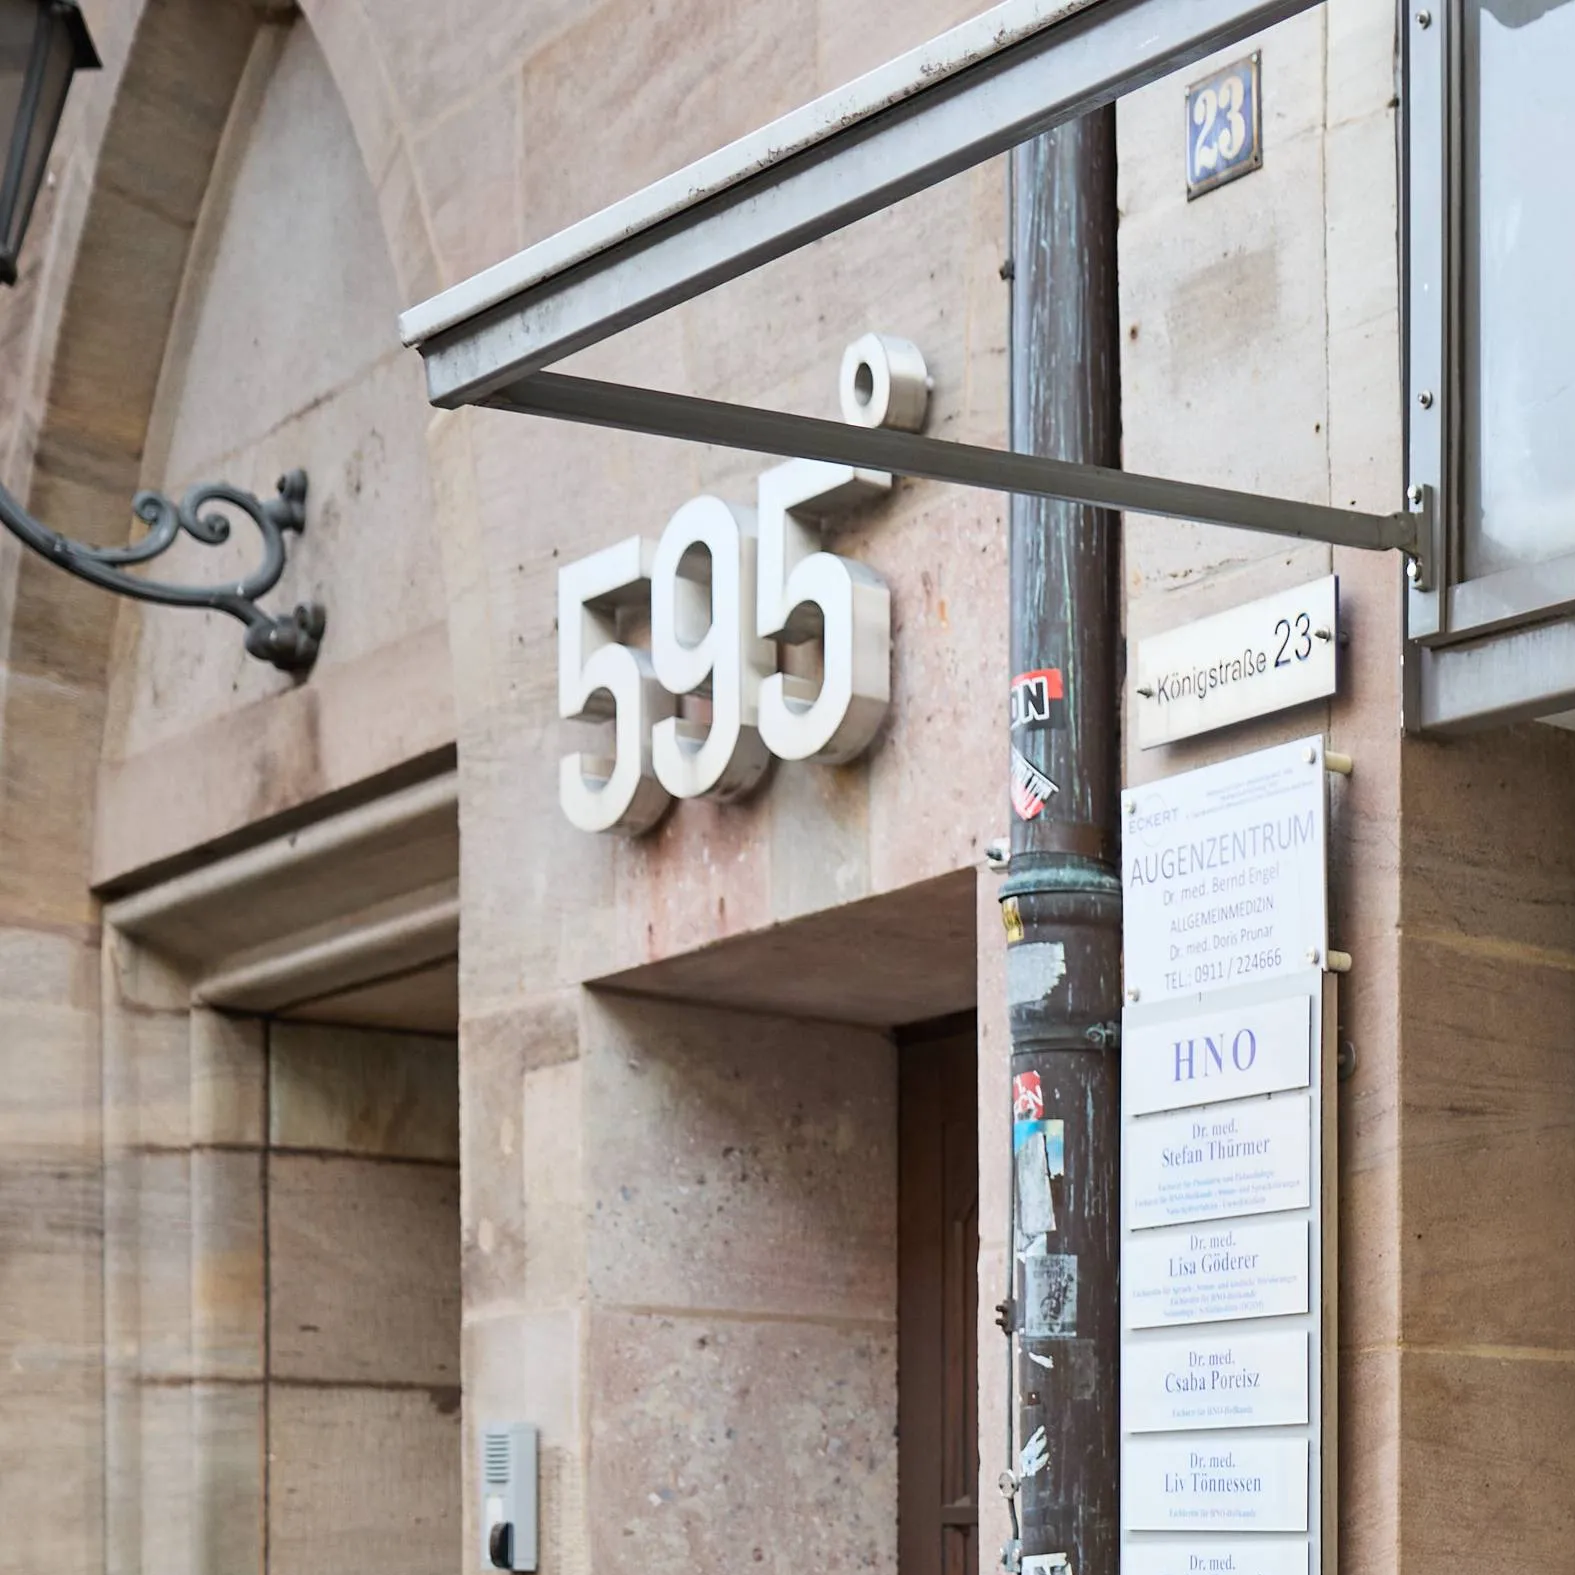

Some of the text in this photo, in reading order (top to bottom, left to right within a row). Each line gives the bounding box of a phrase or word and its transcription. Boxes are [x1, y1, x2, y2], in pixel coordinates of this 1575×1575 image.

[1193, 76, 1245, 177] 23
[1157, 613, 1312, 704] Königstraße 23
[1128, 807, 1179, 834] ECKERT
[1130, 809, 1315, 888] AUGENZENTRUM
[1163, 862, 1280, 906] Dr. med. Bernd Engel
[1170, 895, 1274, 934] ALLGEMEINMEDIZIN
[1170, 922, 1274, 961] Dr. med. Doris Prunar
[1195, 959, 1224, 984] 0911
[1237, 948, 1282, 975] 224666
[1173, 1028, 1257, 1082] HNO
[1192, 1118, 1238, 1139] Dr. med.
[1162, 1136, 1271, 1168] Stefan Thürmer
[1190, 1231, 1236, 1251] Dr. med.
[1169, 1253, 1259, 1277] Lisa Göderer
[1189, 1349, 1235, 1367] Dr. med.
[1165, 1368, 1261, 1393] Csaba Poreisz
[1190, 1452, 1236, 1468] Dr. med.
[1165, 1472, 1261, 1493] Liv Tönnessen
[1190, 1555, 1236, 1570] Dr. med.
